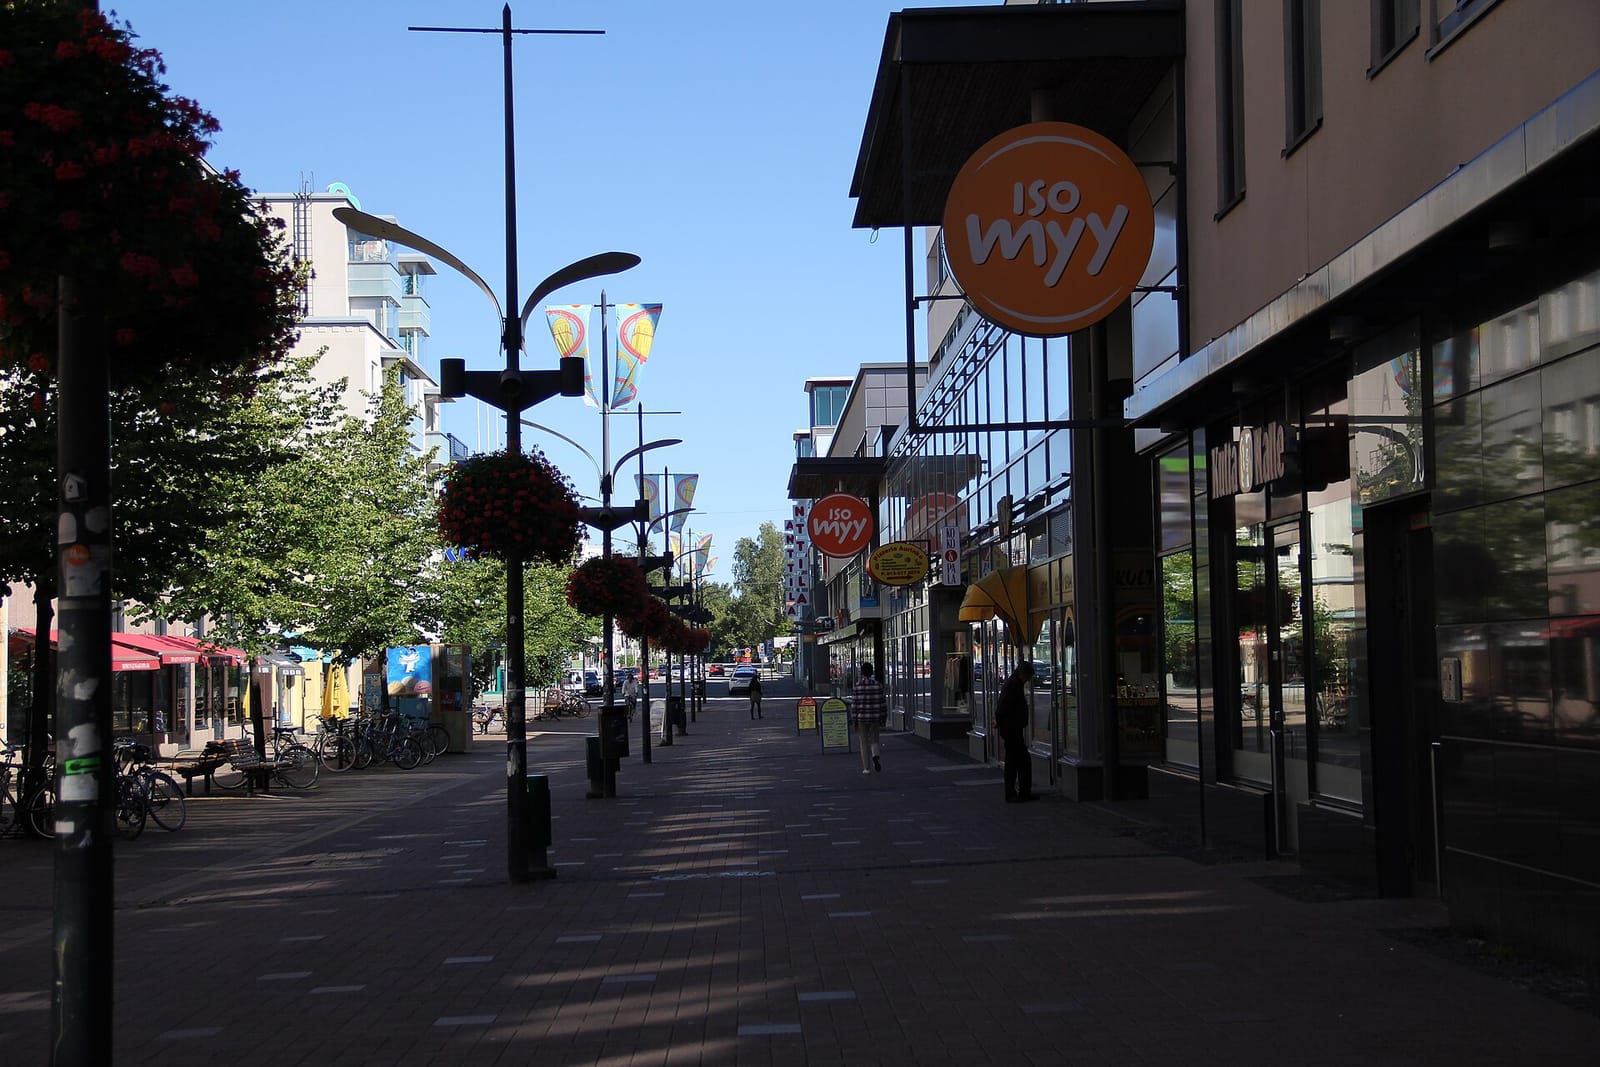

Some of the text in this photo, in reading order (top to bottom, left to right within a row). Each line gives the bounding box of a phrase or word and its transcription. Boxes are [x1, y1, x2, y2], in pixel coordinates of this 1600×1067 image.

[1013, 178, 1081, 217] ISO
[829, 508, 852, 521] ISO
[786, 521, 796, 616] ANTTILA
[794, 506, 807, 604] NTTILA
